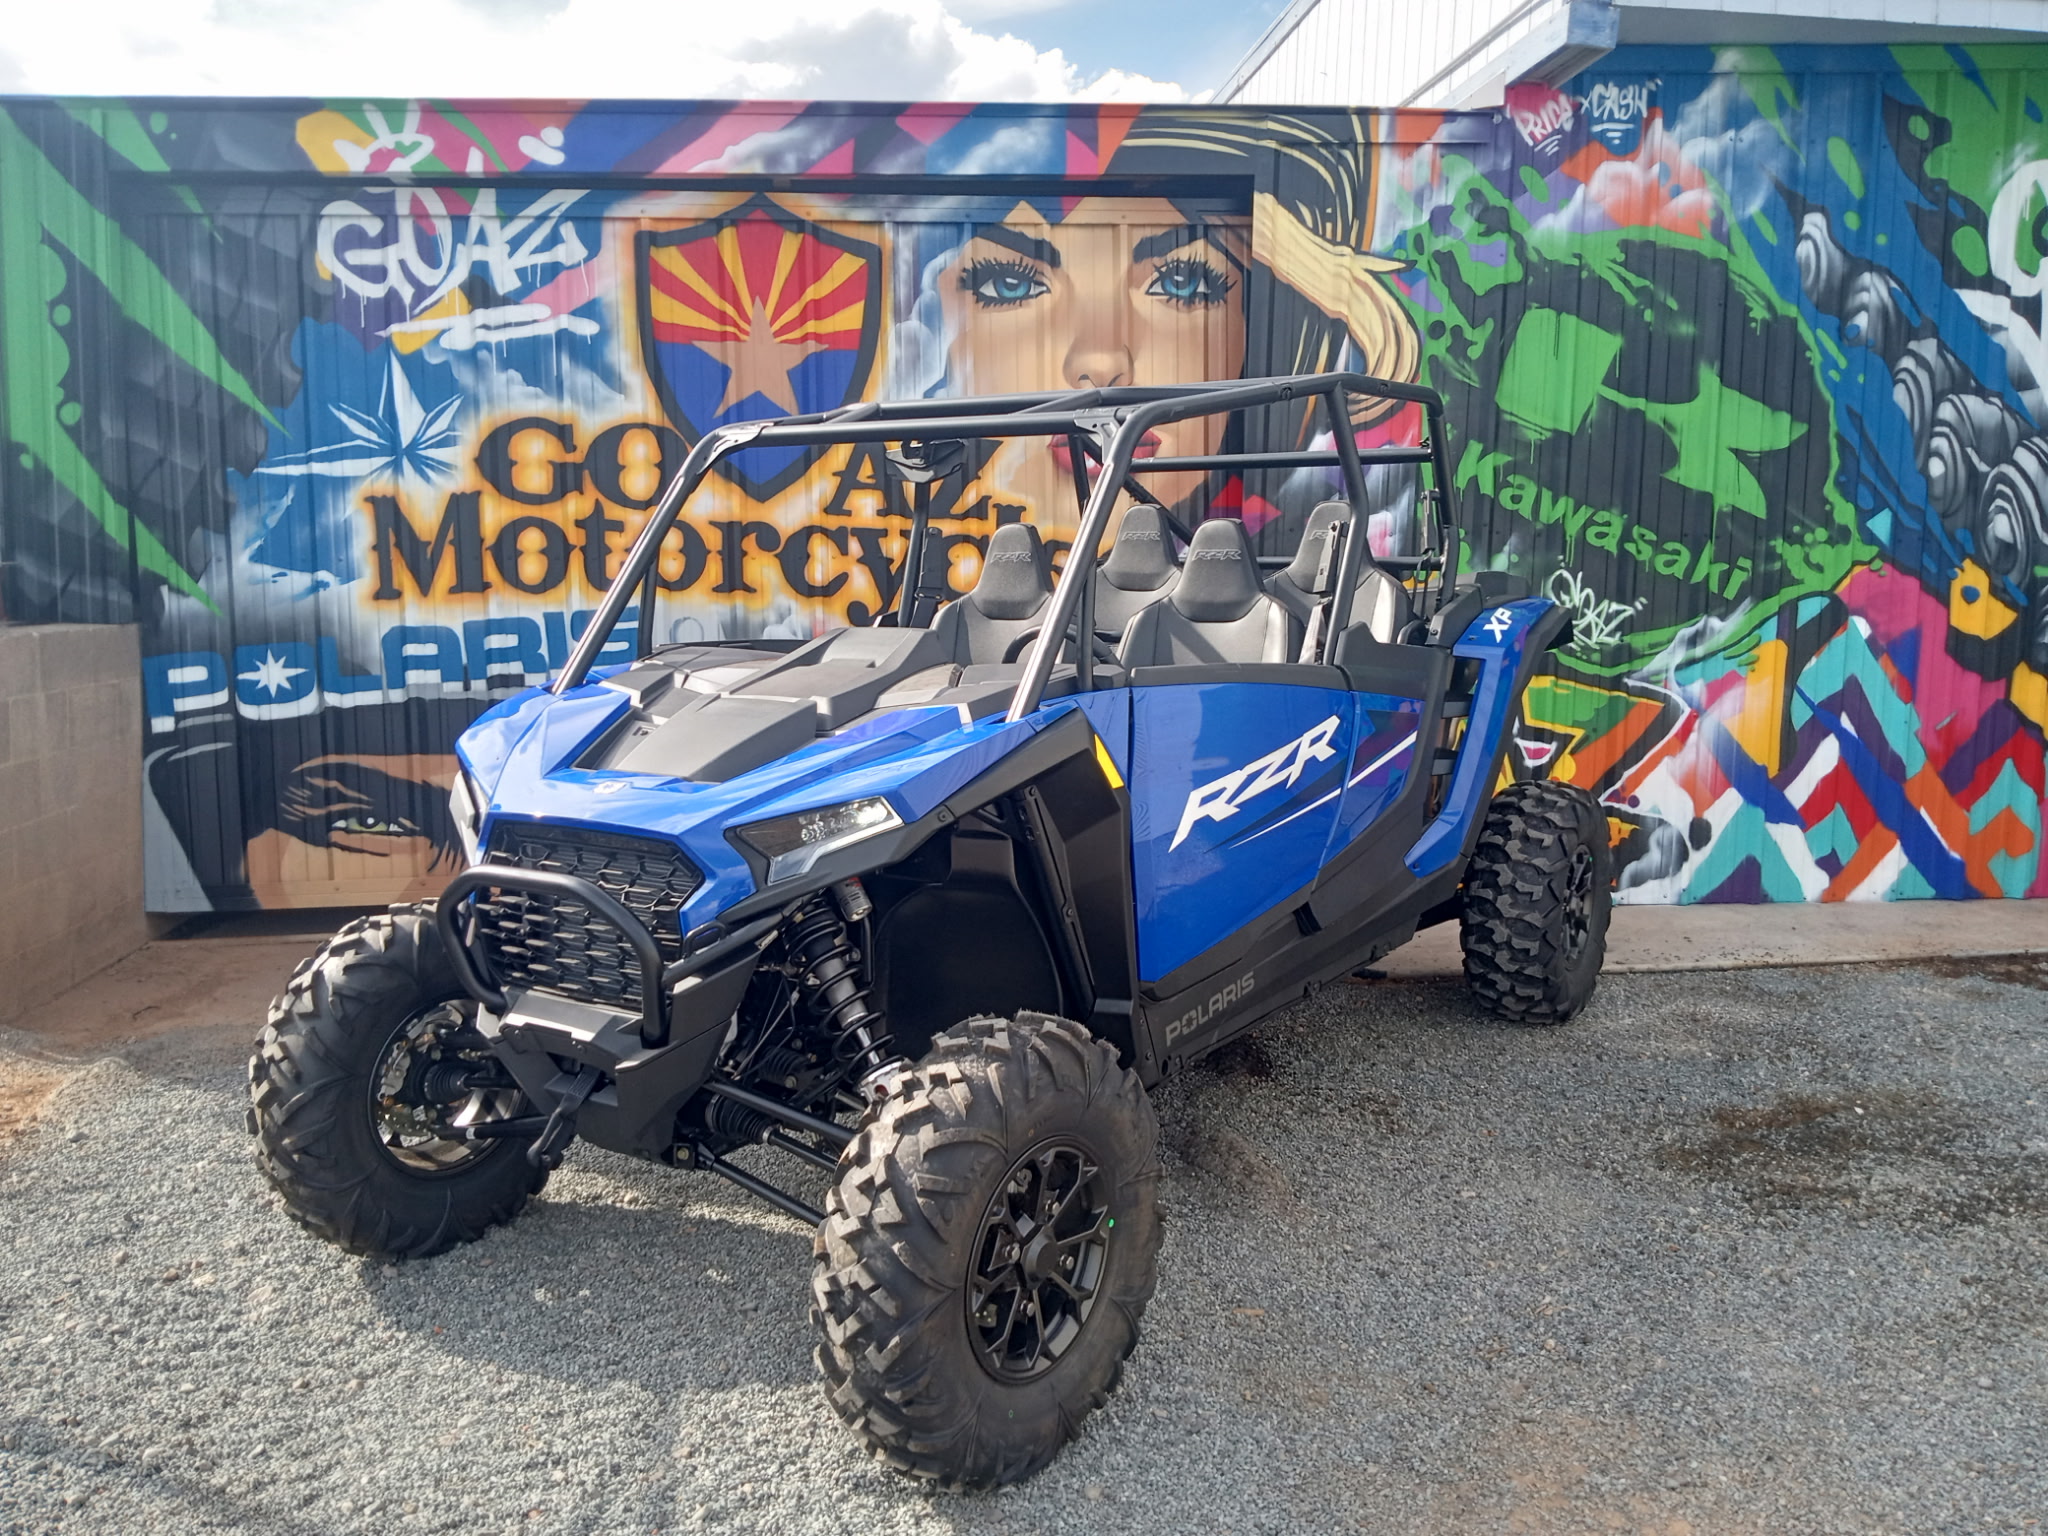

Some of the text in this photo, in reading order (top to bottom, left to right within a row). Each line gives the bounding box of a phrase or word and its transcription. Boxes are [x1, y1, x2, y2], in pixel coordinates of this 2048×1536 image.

[823, 440, 1004, 520] AZ
[363, 490, 1113, 628] Motorcyc
[989, 551, 1032, 564] RZR
[1120, 530, 1161, 542] RZR
[1192, 548, 1242, 561] RZR
[1453, 440, 1754, 601] Kawasaki
[1482, 607, 1513, 644] XP
[143, 605, 640, 733] POLARIS
[1167, 714, 1341, 853] RZR
[1165, 971, 1256, 1048] POLARIS
